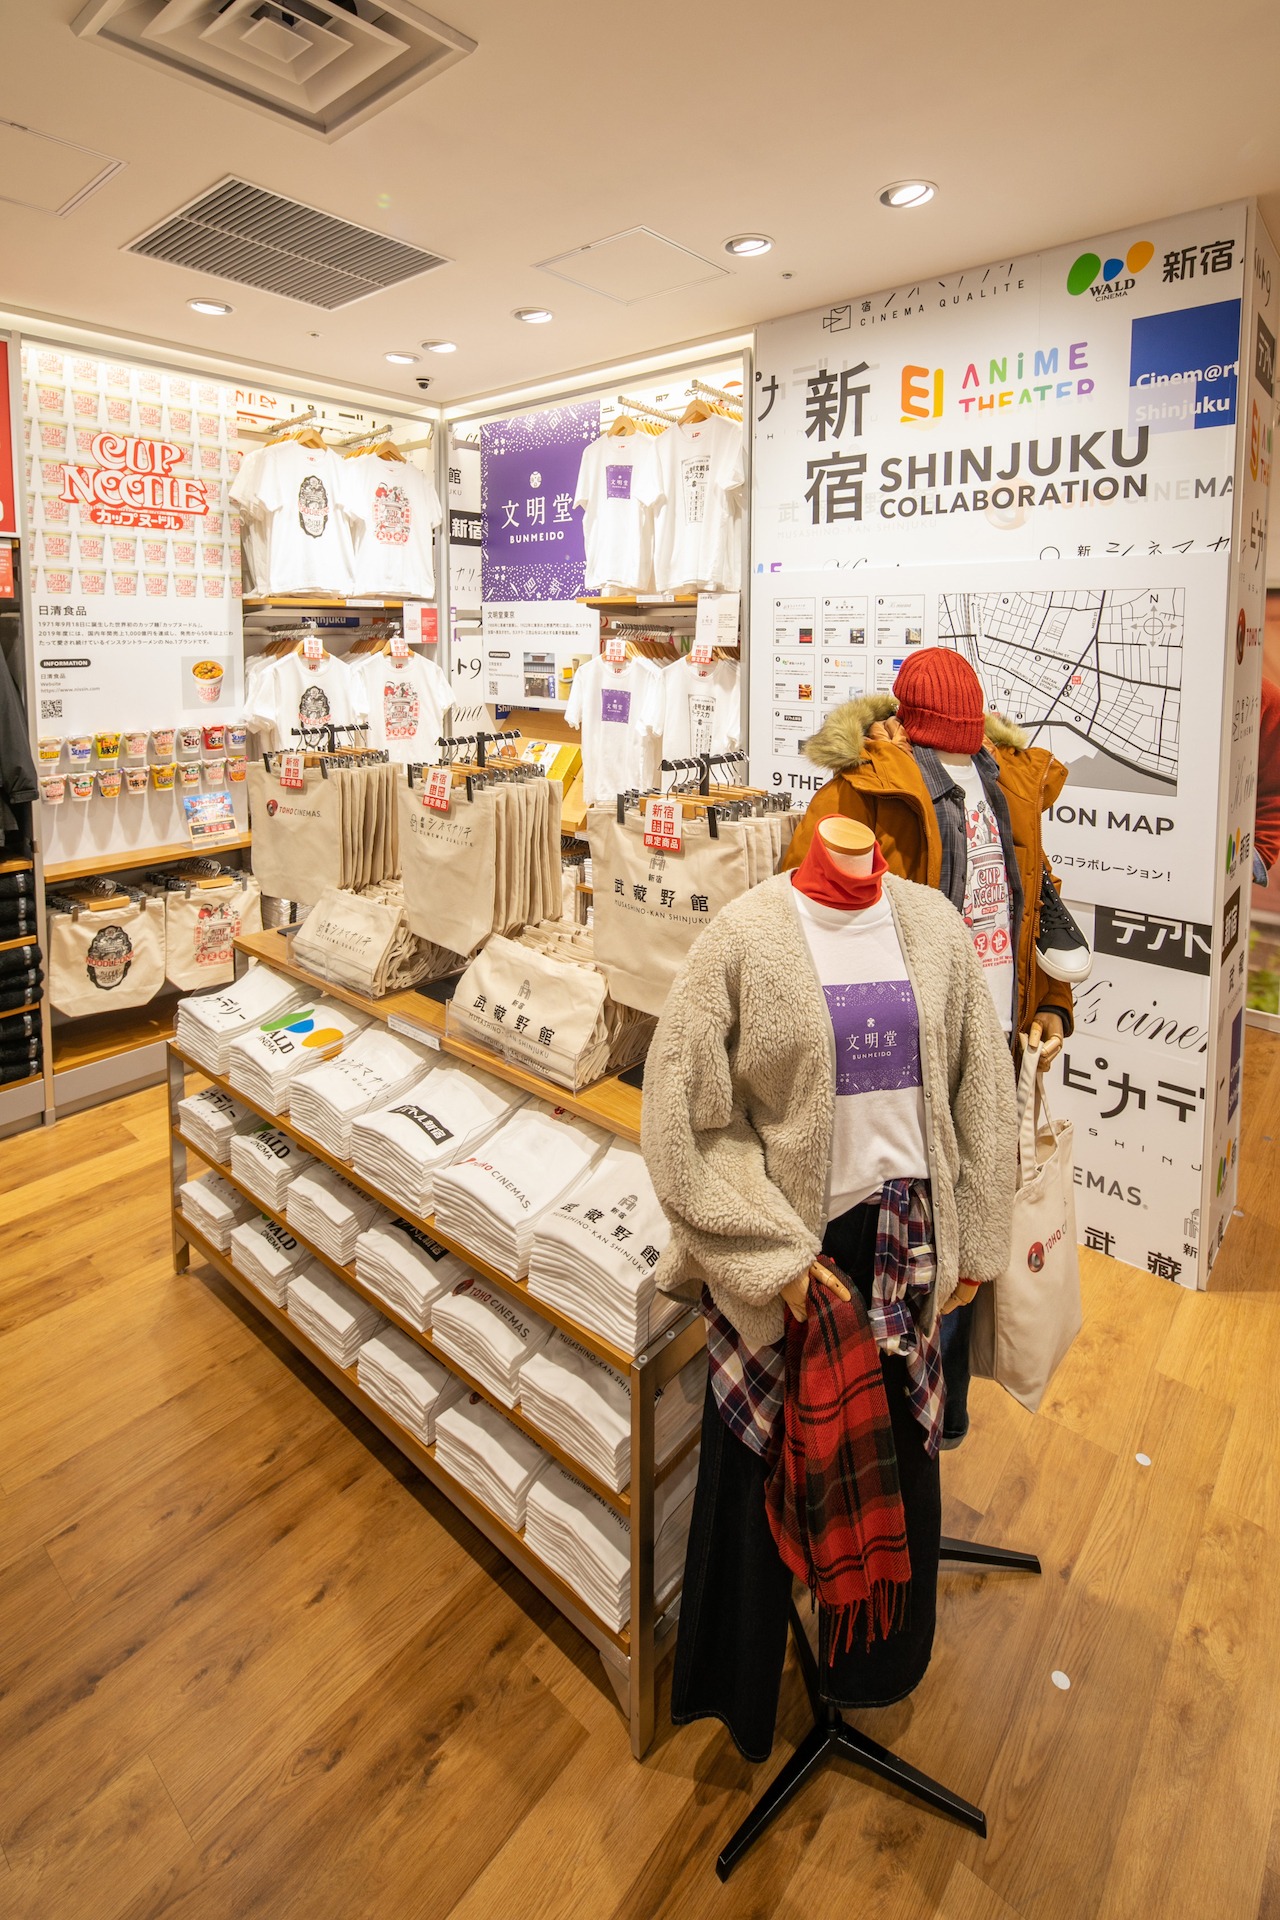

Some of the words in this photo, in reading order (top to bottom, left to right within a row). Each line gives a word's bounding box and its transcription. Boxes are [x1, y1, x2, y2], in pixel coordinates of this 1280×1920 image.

[1089, 278, 1136, 297] WALD
[1095, 291, 1129, 302] CINEMA
[860, 303, 925, 327] CINEMA
[939, 279, 1025, 308] QUALITE
[1135, 396, 1230, 423] Shinjuku
[804, 361, 871, 525] 新宿
[91, 432, 185, 476] CUP
[879, 425, 1149, 493] SHINJUKU
[880, 473, 1148, 519] COLLABORATION
[96, 509, 181, 530] カップヌードル
[501, 492, 574, 530] 文明堂
[509, 530, 565, 545] BUNMEIDO
[39, 605, 88, 617] 日清食品
[432, 772, 448, 785] 新宿
[772, 772, 783, 786] 9
[652, 804, 675, 819] 新宿
[1107, 811, 1175, 836] MAP
[645, 835, 680, 850] 限定商品
[648, 874, 663, 884] 新宿
[977, 867, 1001, 888] CUP
[668, 913, 711, 925] SHINJUKU
[845, 1030, 898, 1052] 文明堂
[852, 1050, 892, 1061] BUNMEIDO
[610, 1206, 627, 1220] 新宿
[260, 1230, 281, 1254] CINEMA
[264, 1220, 298, 1251] WALD
[1044, 1228, 1063, 1254] TOHO
[609, 1243, 649, 1276] SHINJUKU
[469, 1286, 492, 1303] TOHO
[558, 1332, 615, 1377] MUSASHINO-KAN
[559, 1469, 609, 1506] MUSASHINO-KAN
